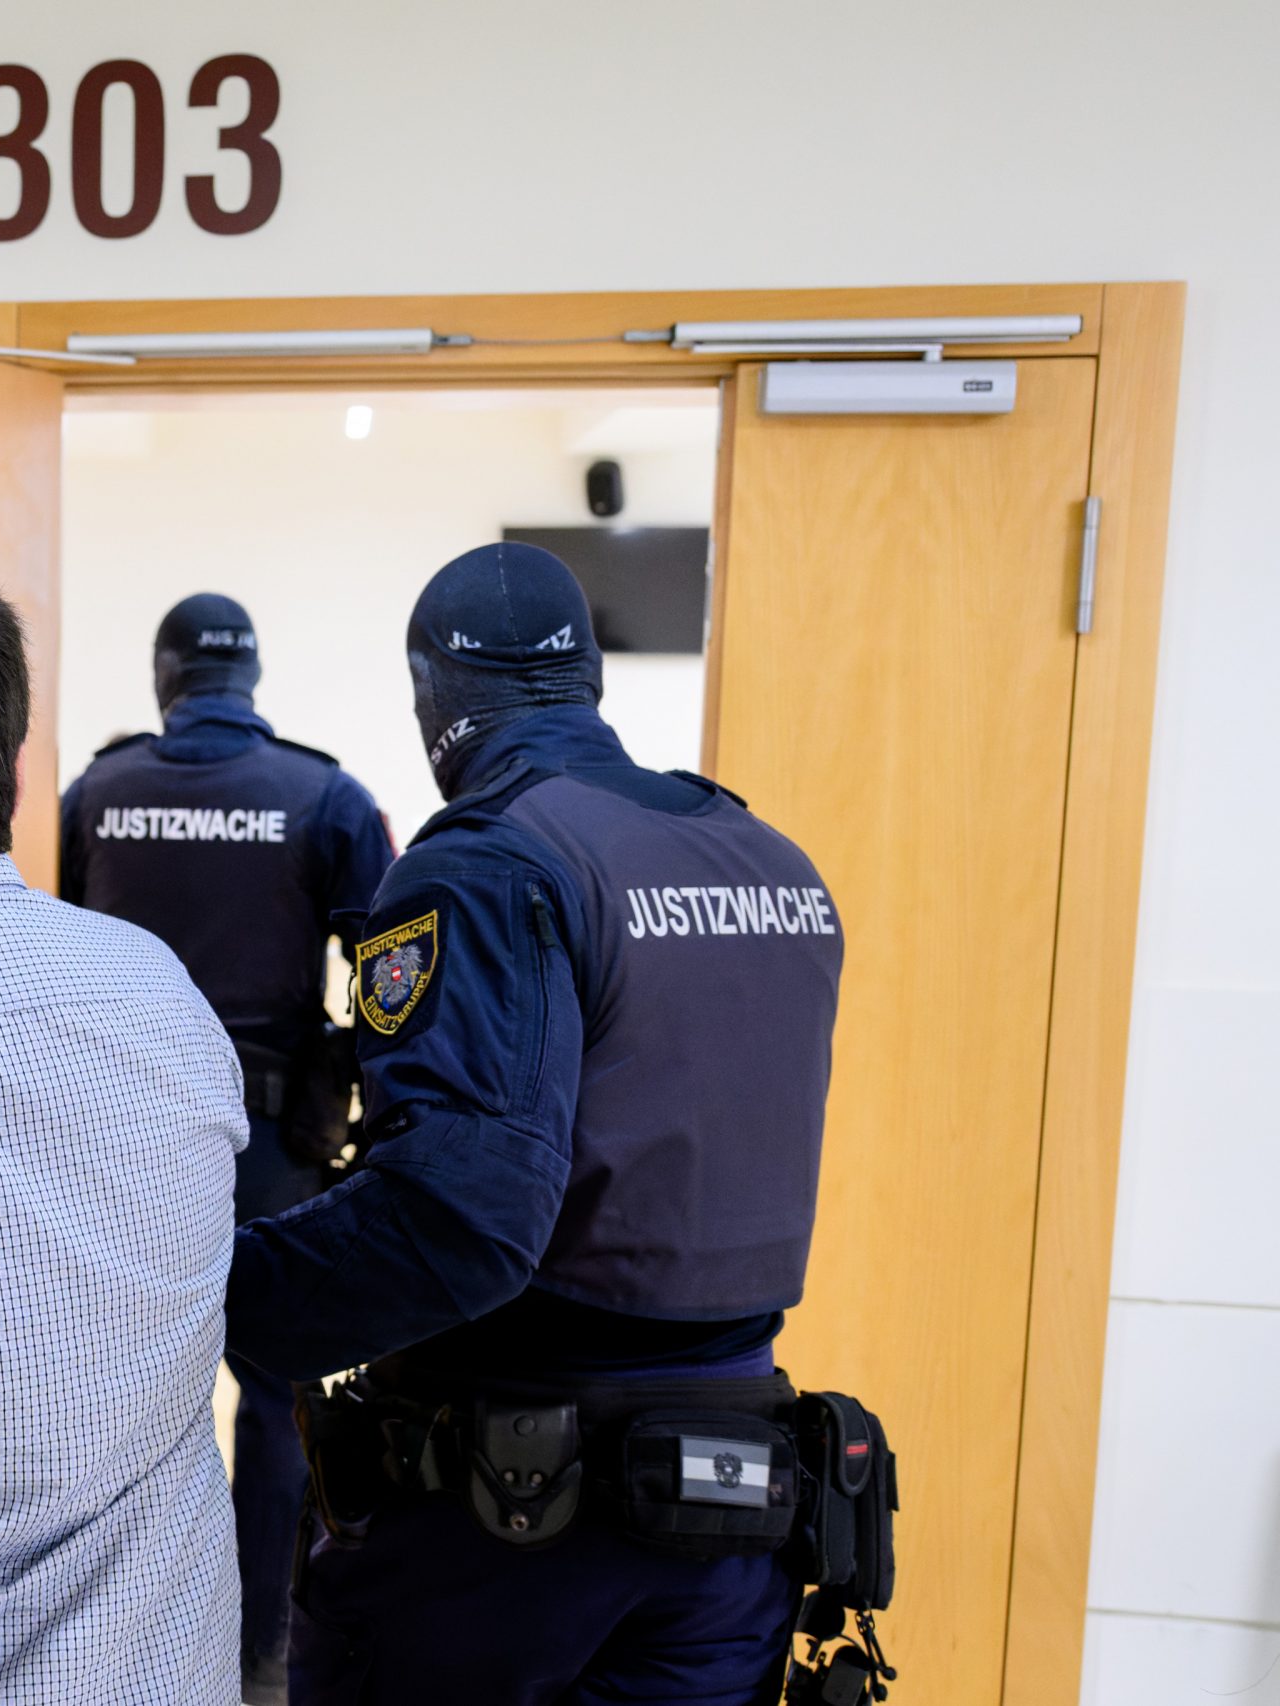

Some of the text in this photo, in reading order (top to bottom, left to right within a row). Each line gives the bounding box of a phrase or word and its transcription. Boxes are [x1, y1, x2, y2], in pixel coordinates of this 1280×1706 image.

[96, 807, 286, 842] JUSTIZWACHE
[626, 886, 835, 939] JUSTIZWACHE
[360, 917, 434, 961] JUSTIZWACHE
